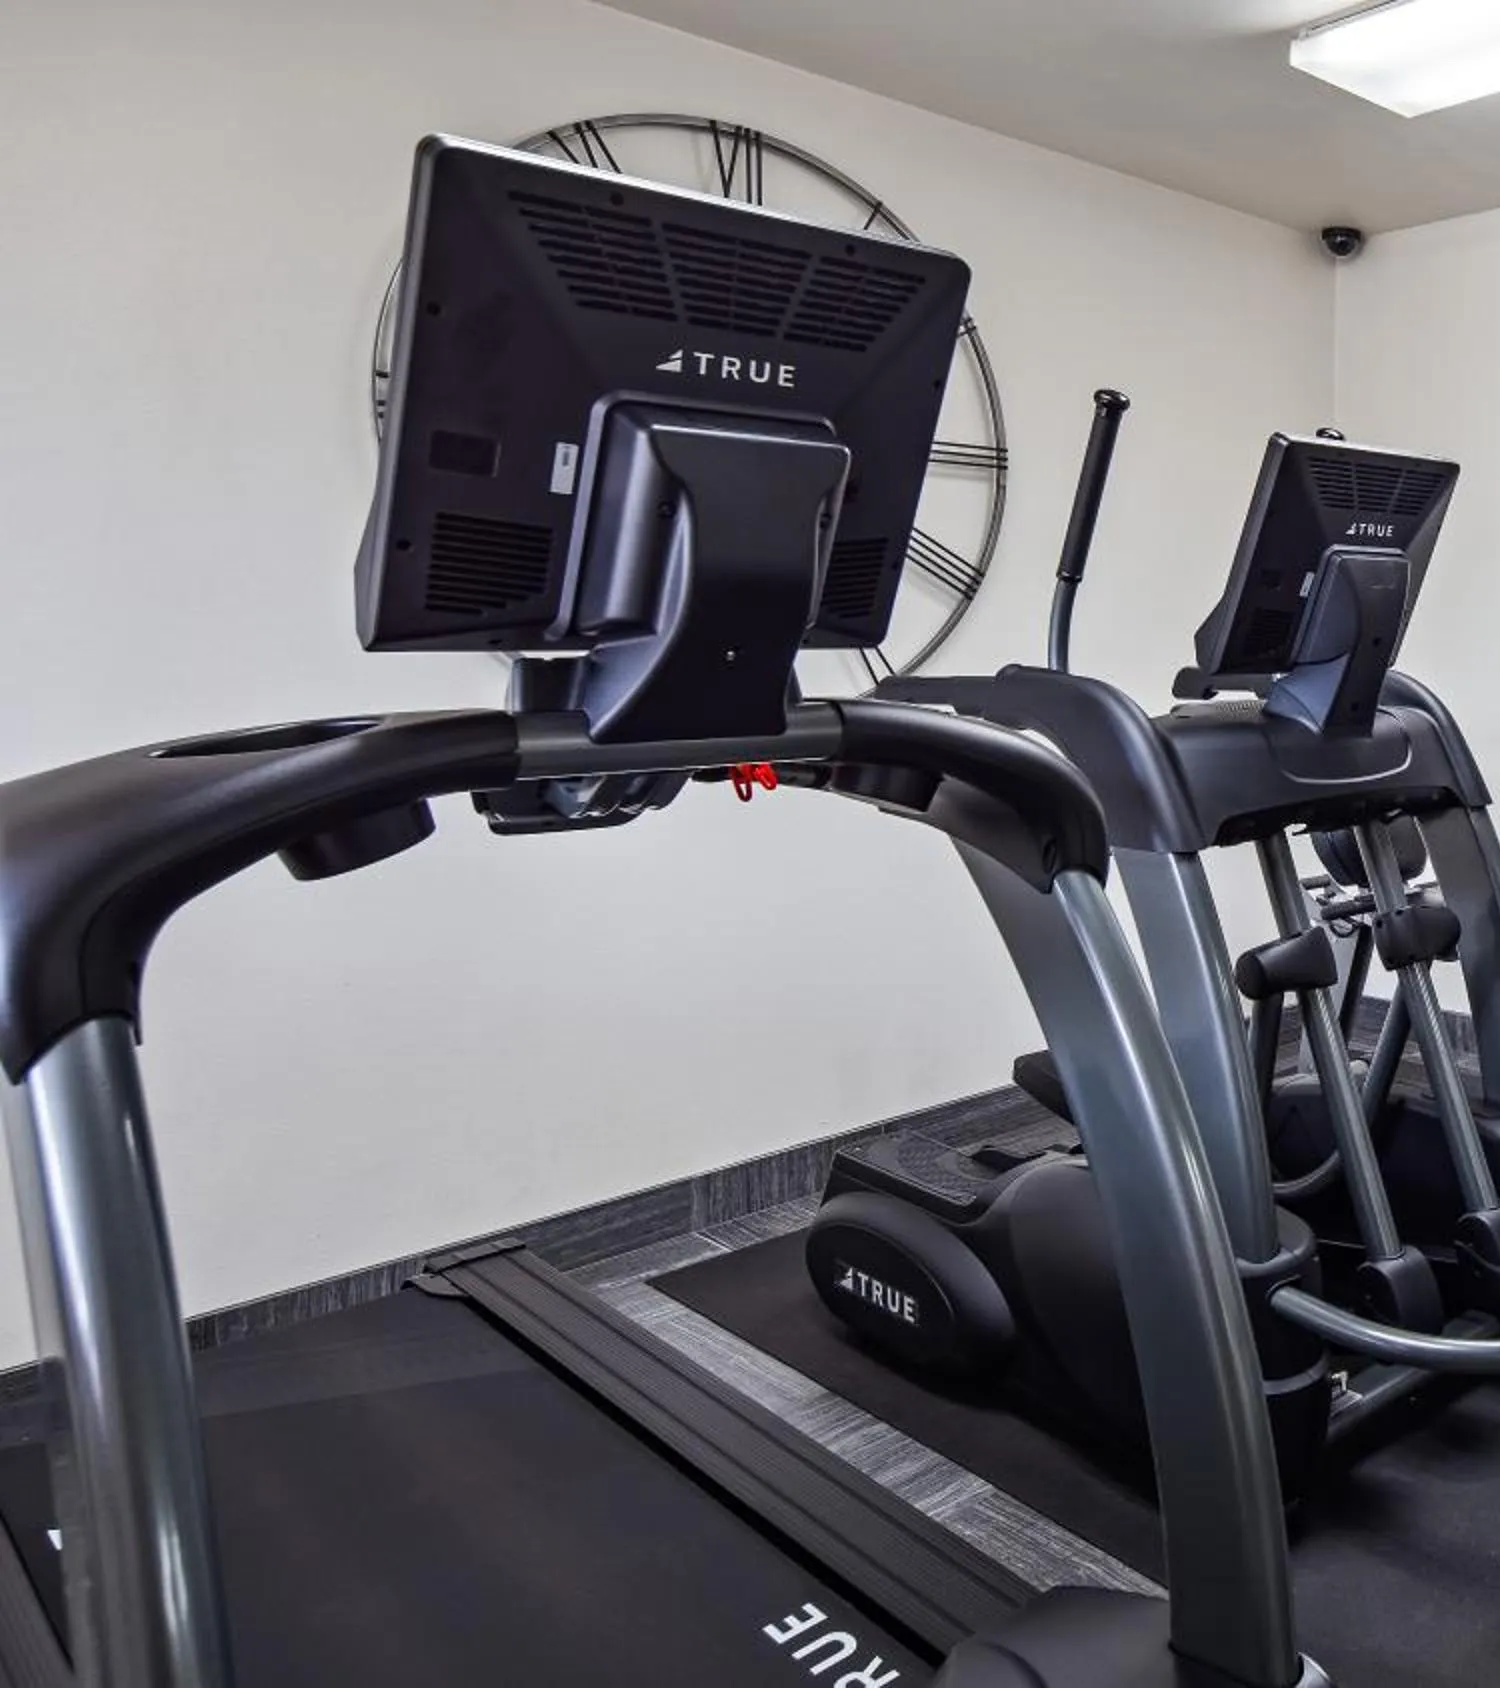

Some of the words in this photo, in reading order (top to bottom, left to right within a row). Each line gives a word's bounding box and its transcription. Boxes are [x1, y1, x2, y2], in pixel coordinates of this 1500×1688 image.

[693, 351, 796, 388] TRUE
[1359, 523, 1394, 537] TRUE
[857, 1271, 916, 1324] TRUE
[762, 1602, 901, 1688] RUE
